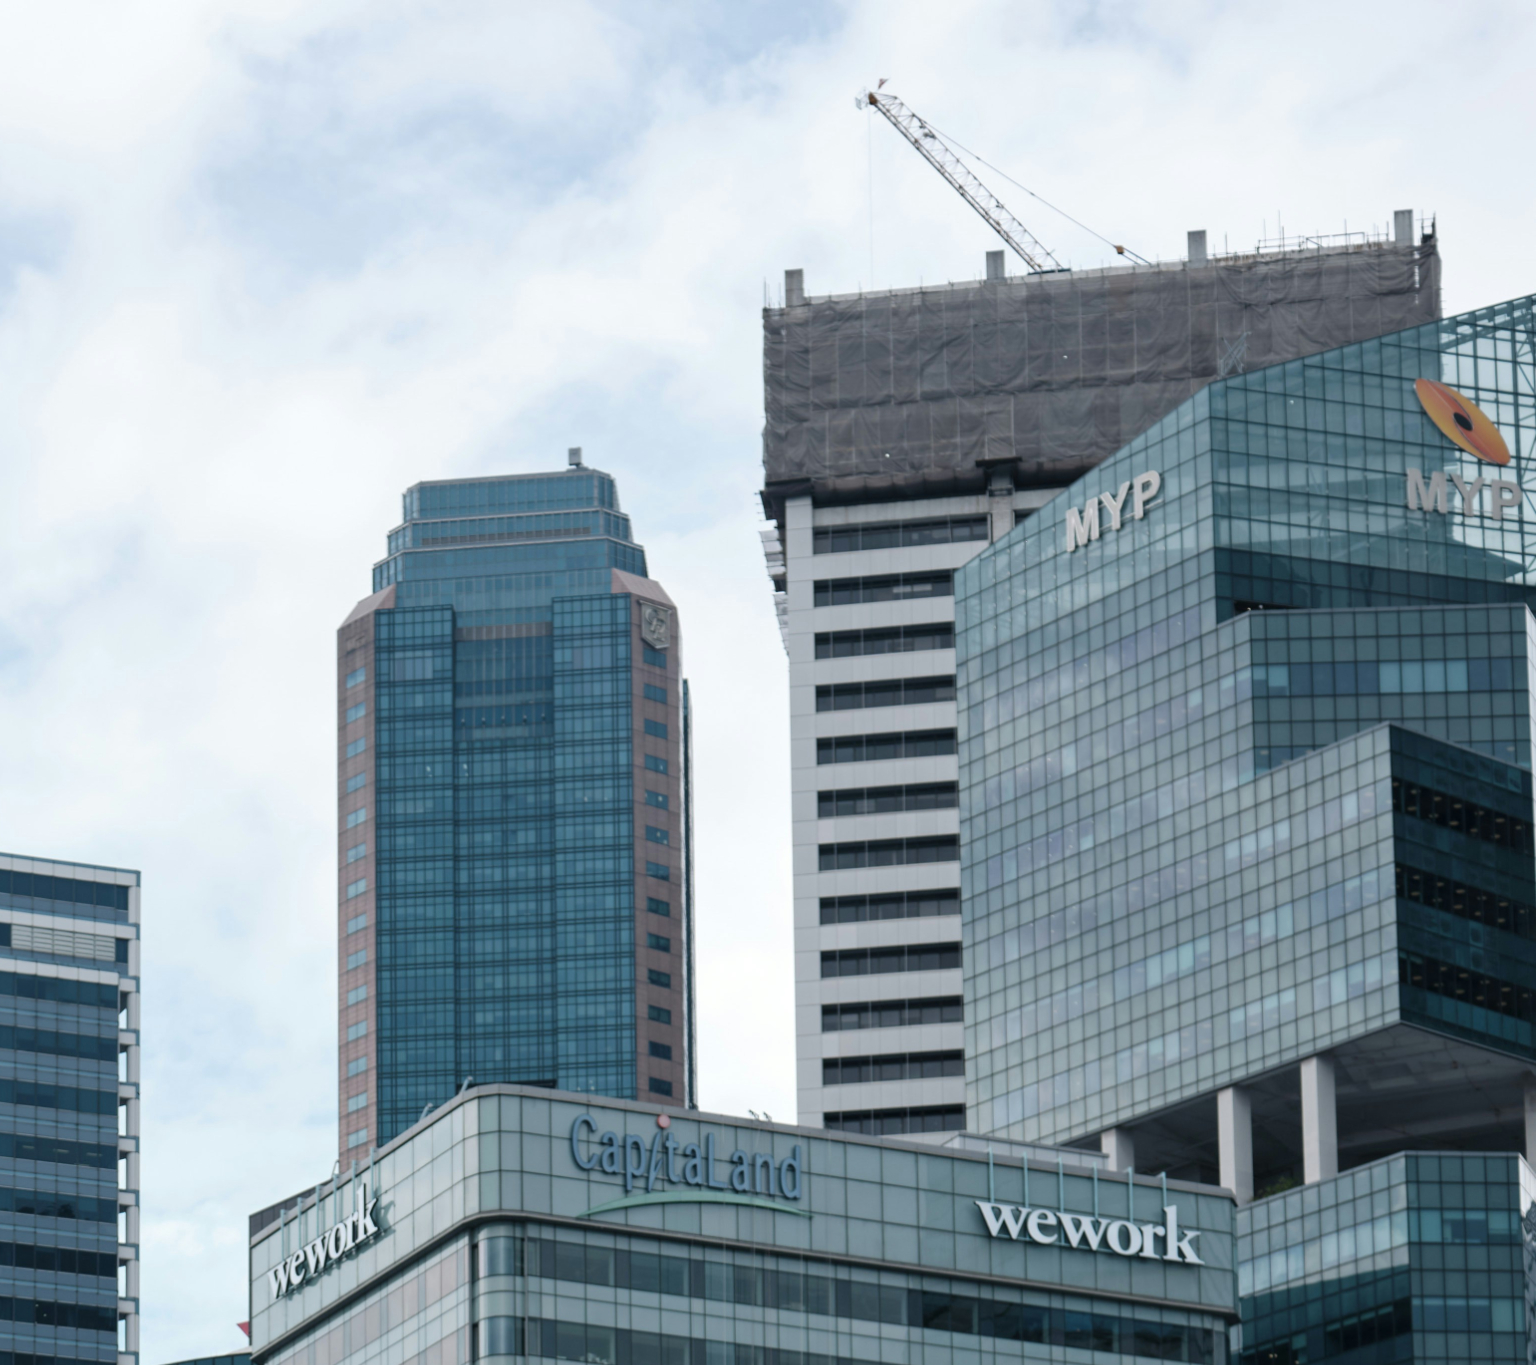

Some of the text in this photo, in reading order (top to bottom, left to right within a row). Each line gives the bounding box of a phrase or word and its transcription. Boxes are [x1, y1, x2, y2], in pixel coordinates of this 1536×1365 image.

[1066, 469, 1162, 552] MYP
[1406, 468, 1522, 520] MYP
[571, 1113, 802, 1200] CapitaLand
[267, 1182, 379, 1299] wework
[974, 1200, 1206, 1265] wework
